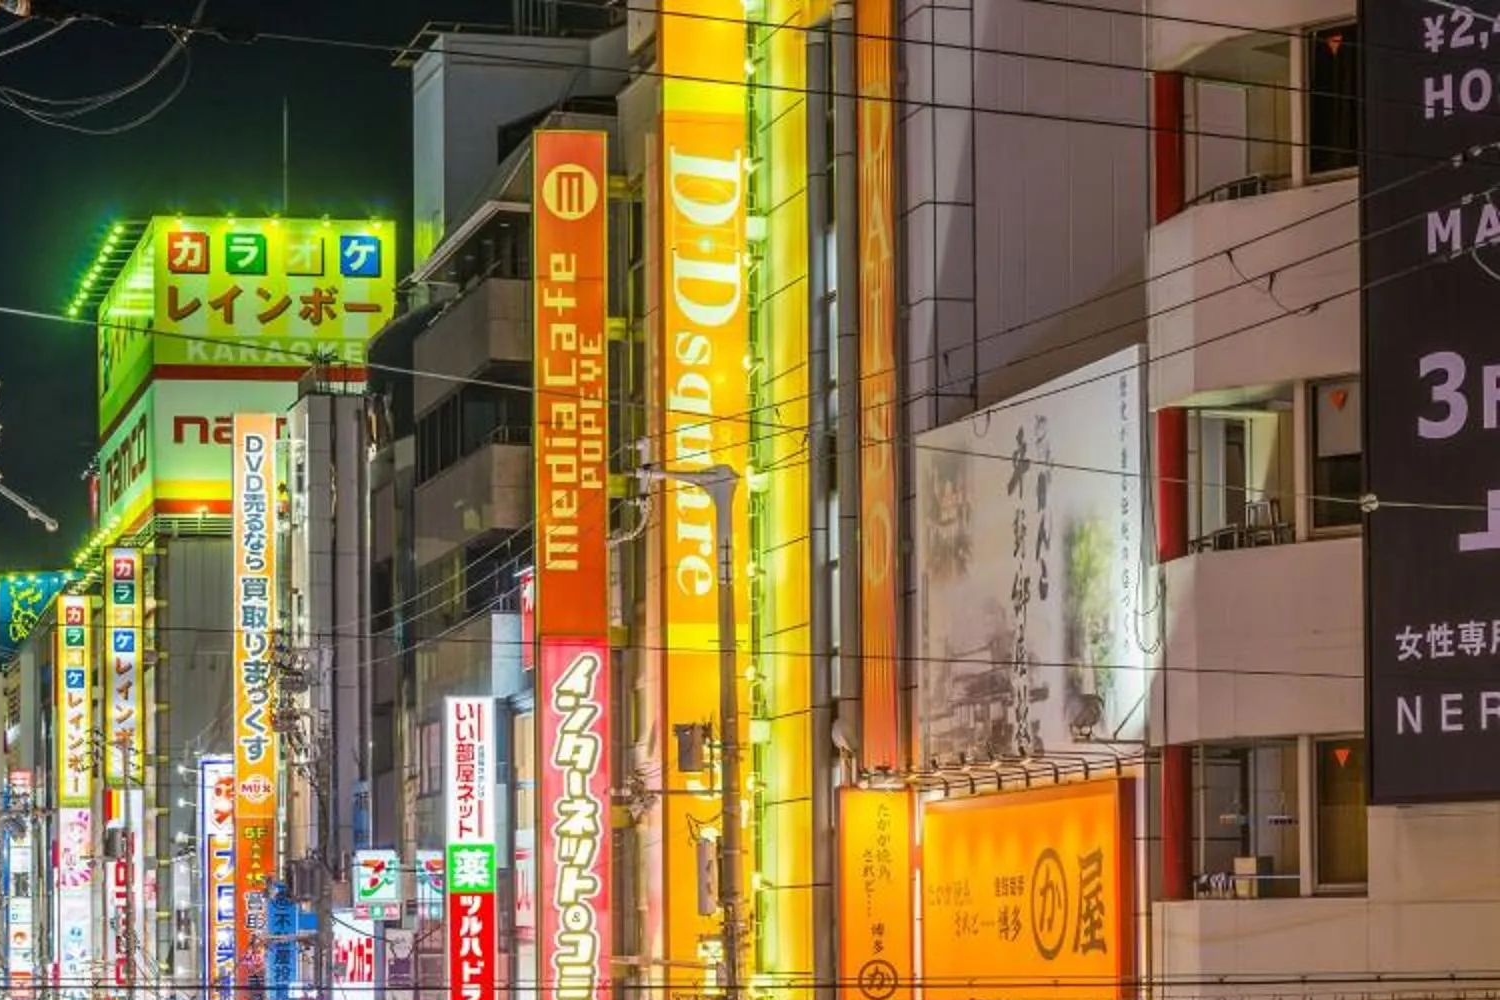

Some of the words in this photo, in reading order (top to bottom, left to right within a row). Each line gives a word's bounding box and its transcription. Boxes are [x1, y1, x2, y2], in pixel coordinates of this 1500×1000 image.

[1423, 7, 1500, 53] ¥2,
[170, 234, 378, 274] カラオケ
[168, 286, 382, 325] レインボー
[581, 333, 603, 489] POPEYE
[114, 558, 136, 750] カラオケレインボ
[456, 703, 475, 838] いい部屋ネット
[454, 849, 490, 888] 薬
